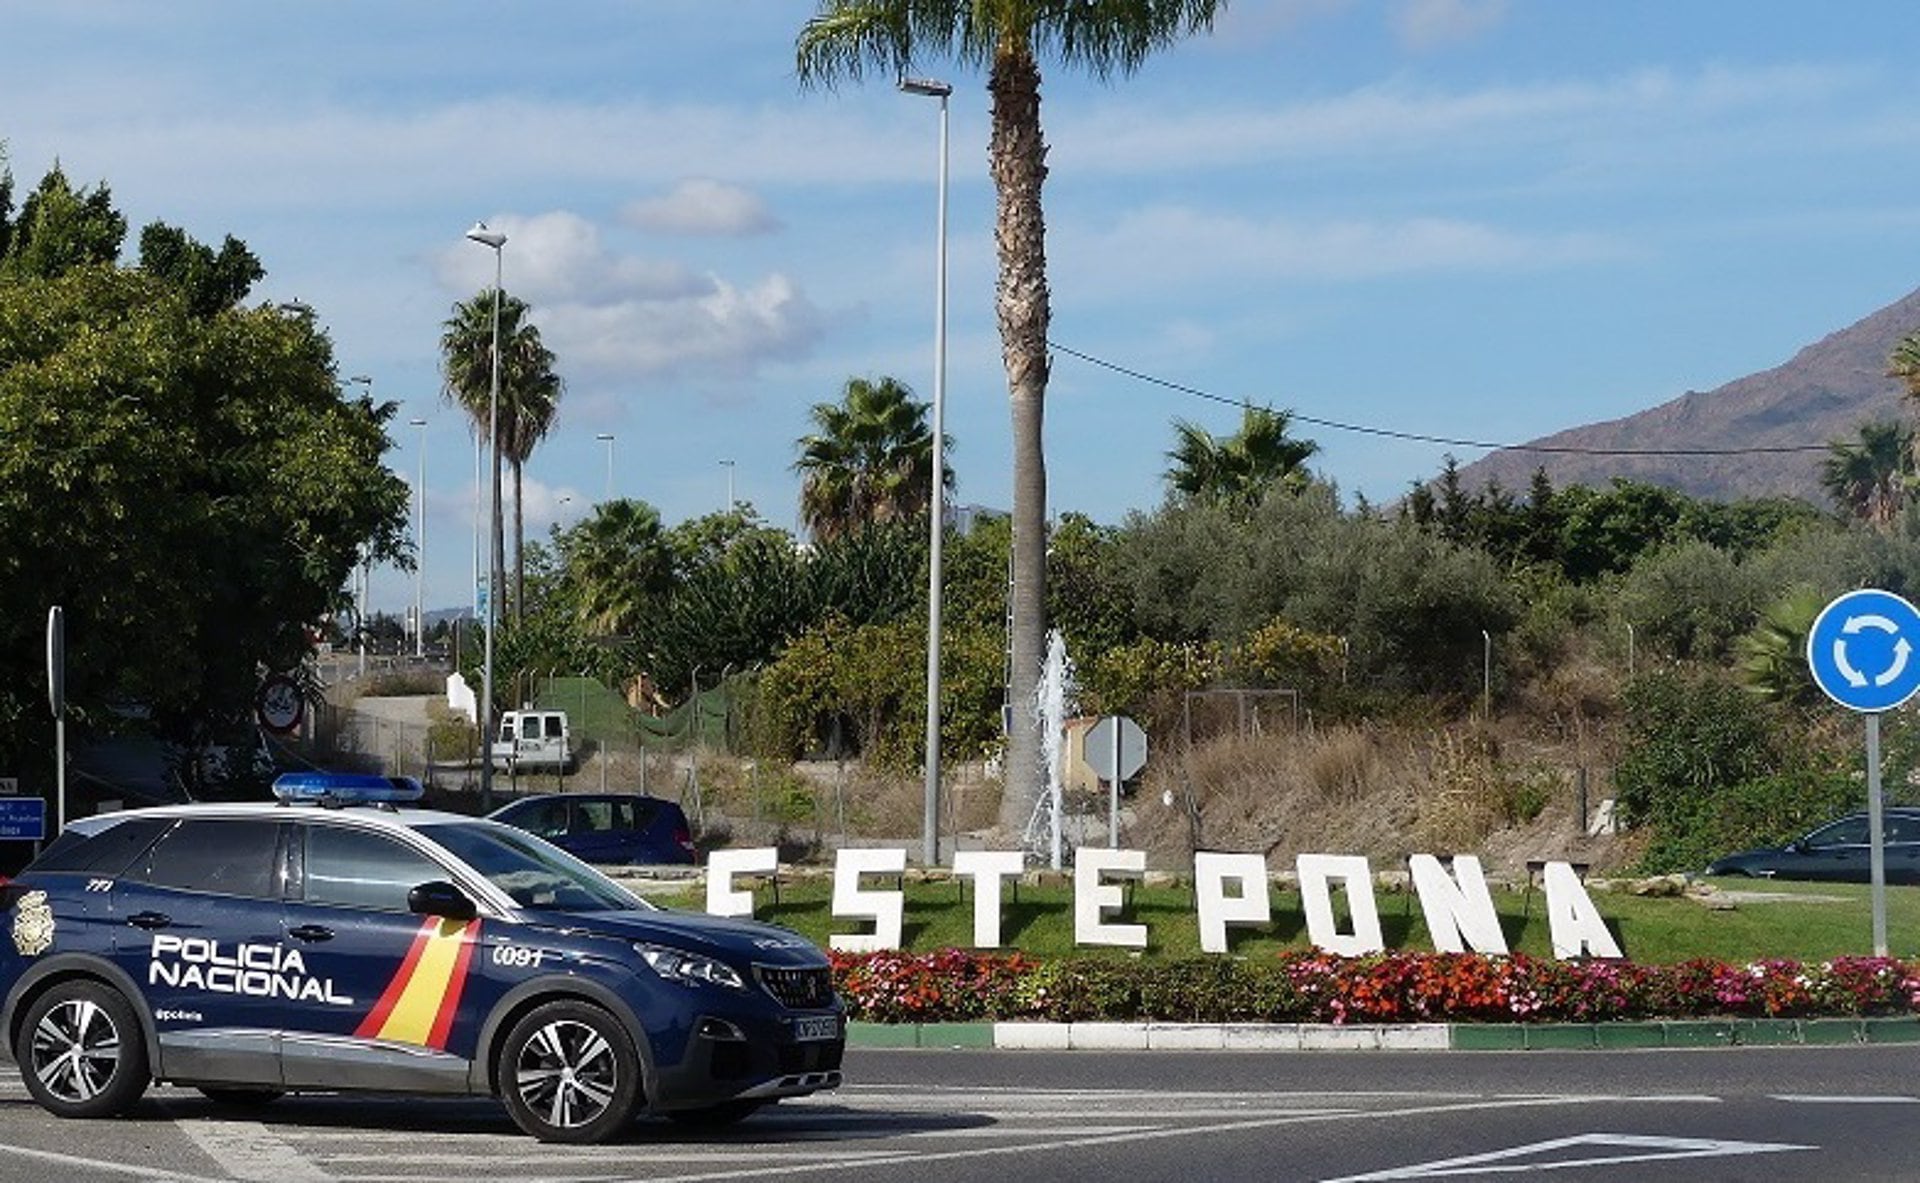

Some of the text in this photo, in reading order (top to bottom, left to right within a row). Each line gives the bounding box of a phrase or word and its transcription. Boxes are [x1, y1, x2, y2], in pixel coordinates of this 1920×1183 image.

[706, 846, 1624, 960] ESTEPONA
[151, 934, 307, 975] POLICÍA
[148, 959, 355, 1006] NACIONAL
